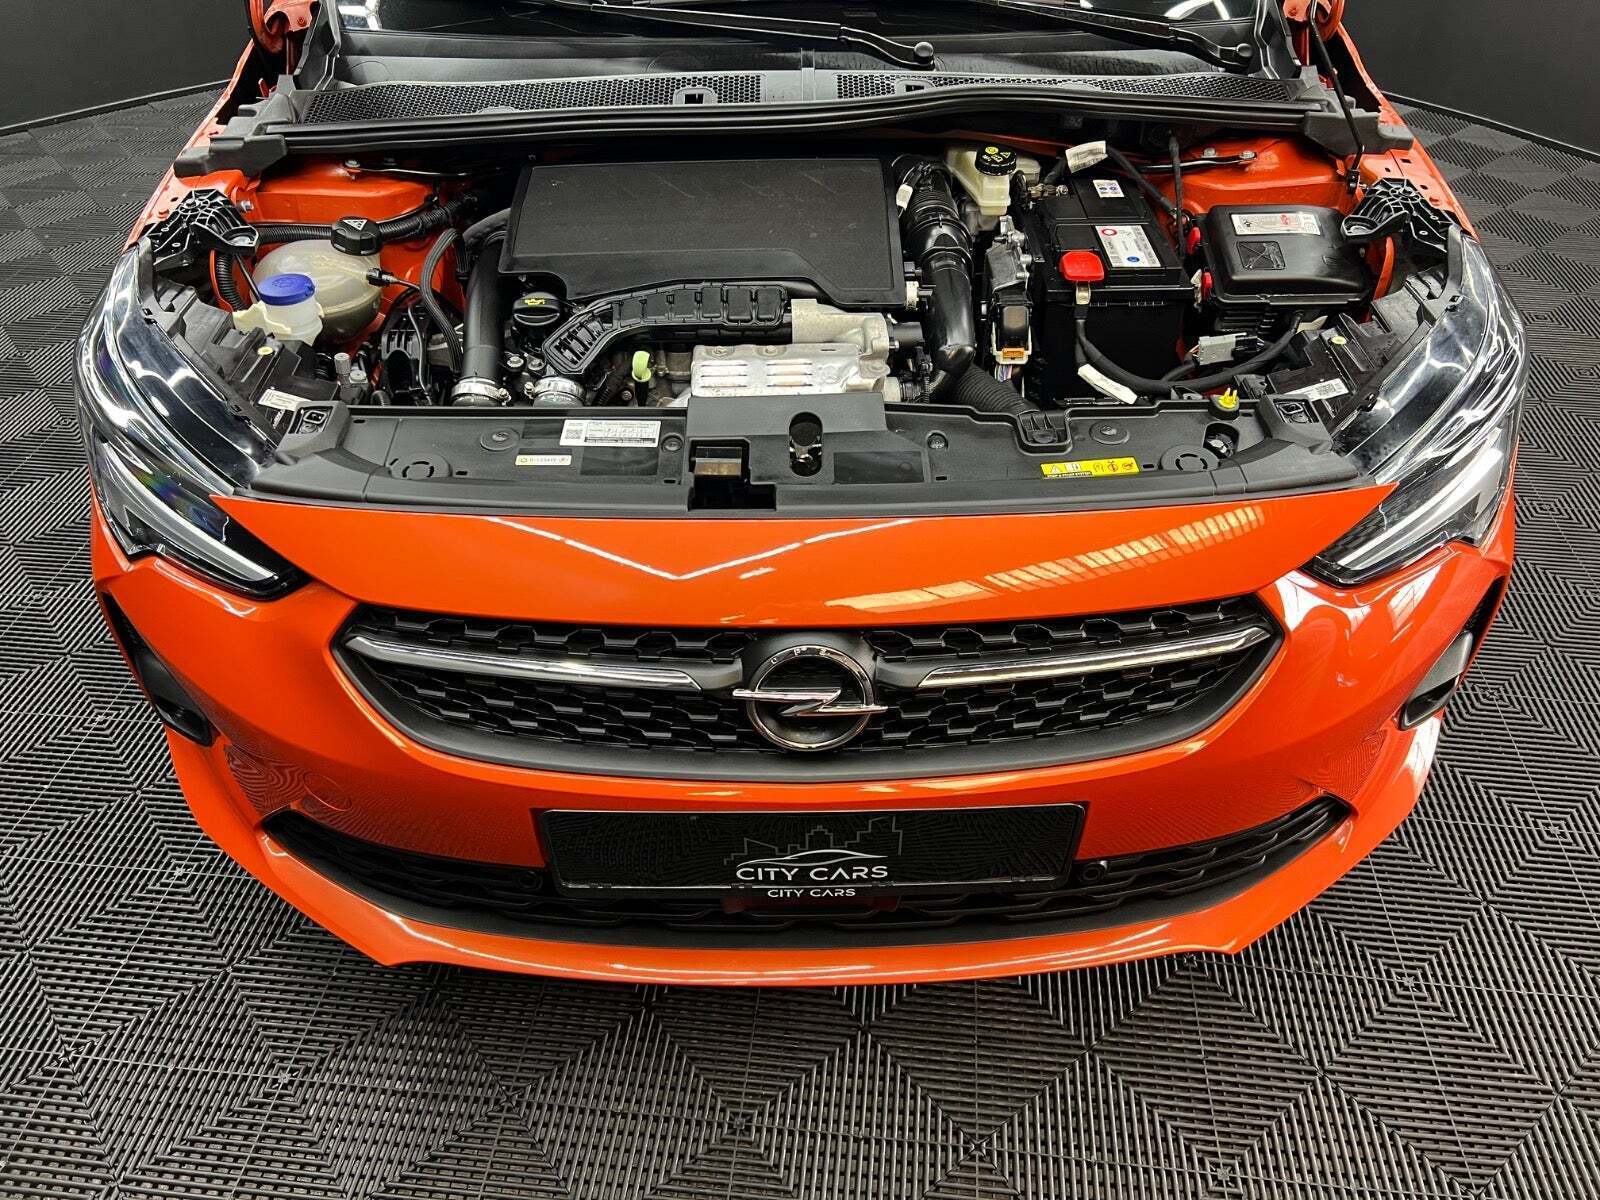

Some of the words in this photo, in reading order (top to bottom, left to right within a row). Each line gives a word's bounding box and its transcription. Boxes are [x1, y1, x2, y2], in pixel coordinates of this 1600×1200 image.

[736, 867, 799, 881] CITY
[809, 866, 888, 881] CARS
[767, 889, 804, 898] CITY
[809, 888, 856, 897] CARS
